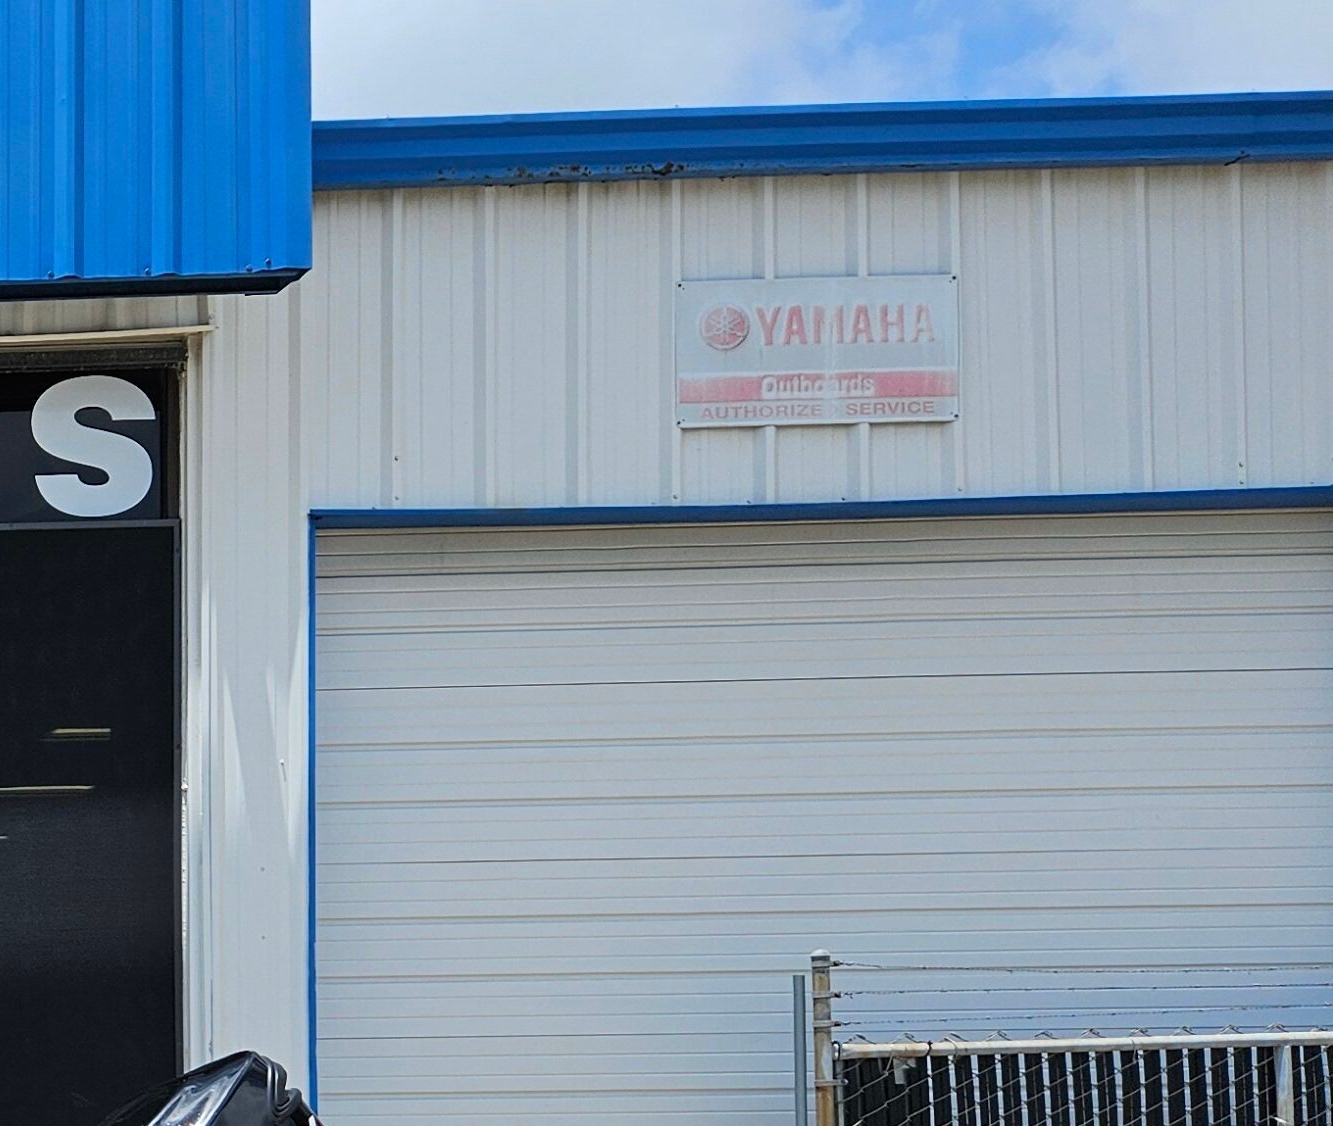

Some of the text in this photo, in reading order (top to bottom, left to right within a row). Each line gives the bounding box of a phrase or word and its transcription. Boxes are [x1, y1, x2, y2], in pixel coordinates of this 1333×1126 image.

[755, 304, 936, 346] YAMAHA
[762, 373, 874, 397] Outbords
[701, 400, 934, 419] AUTHORIZE SERVICE
